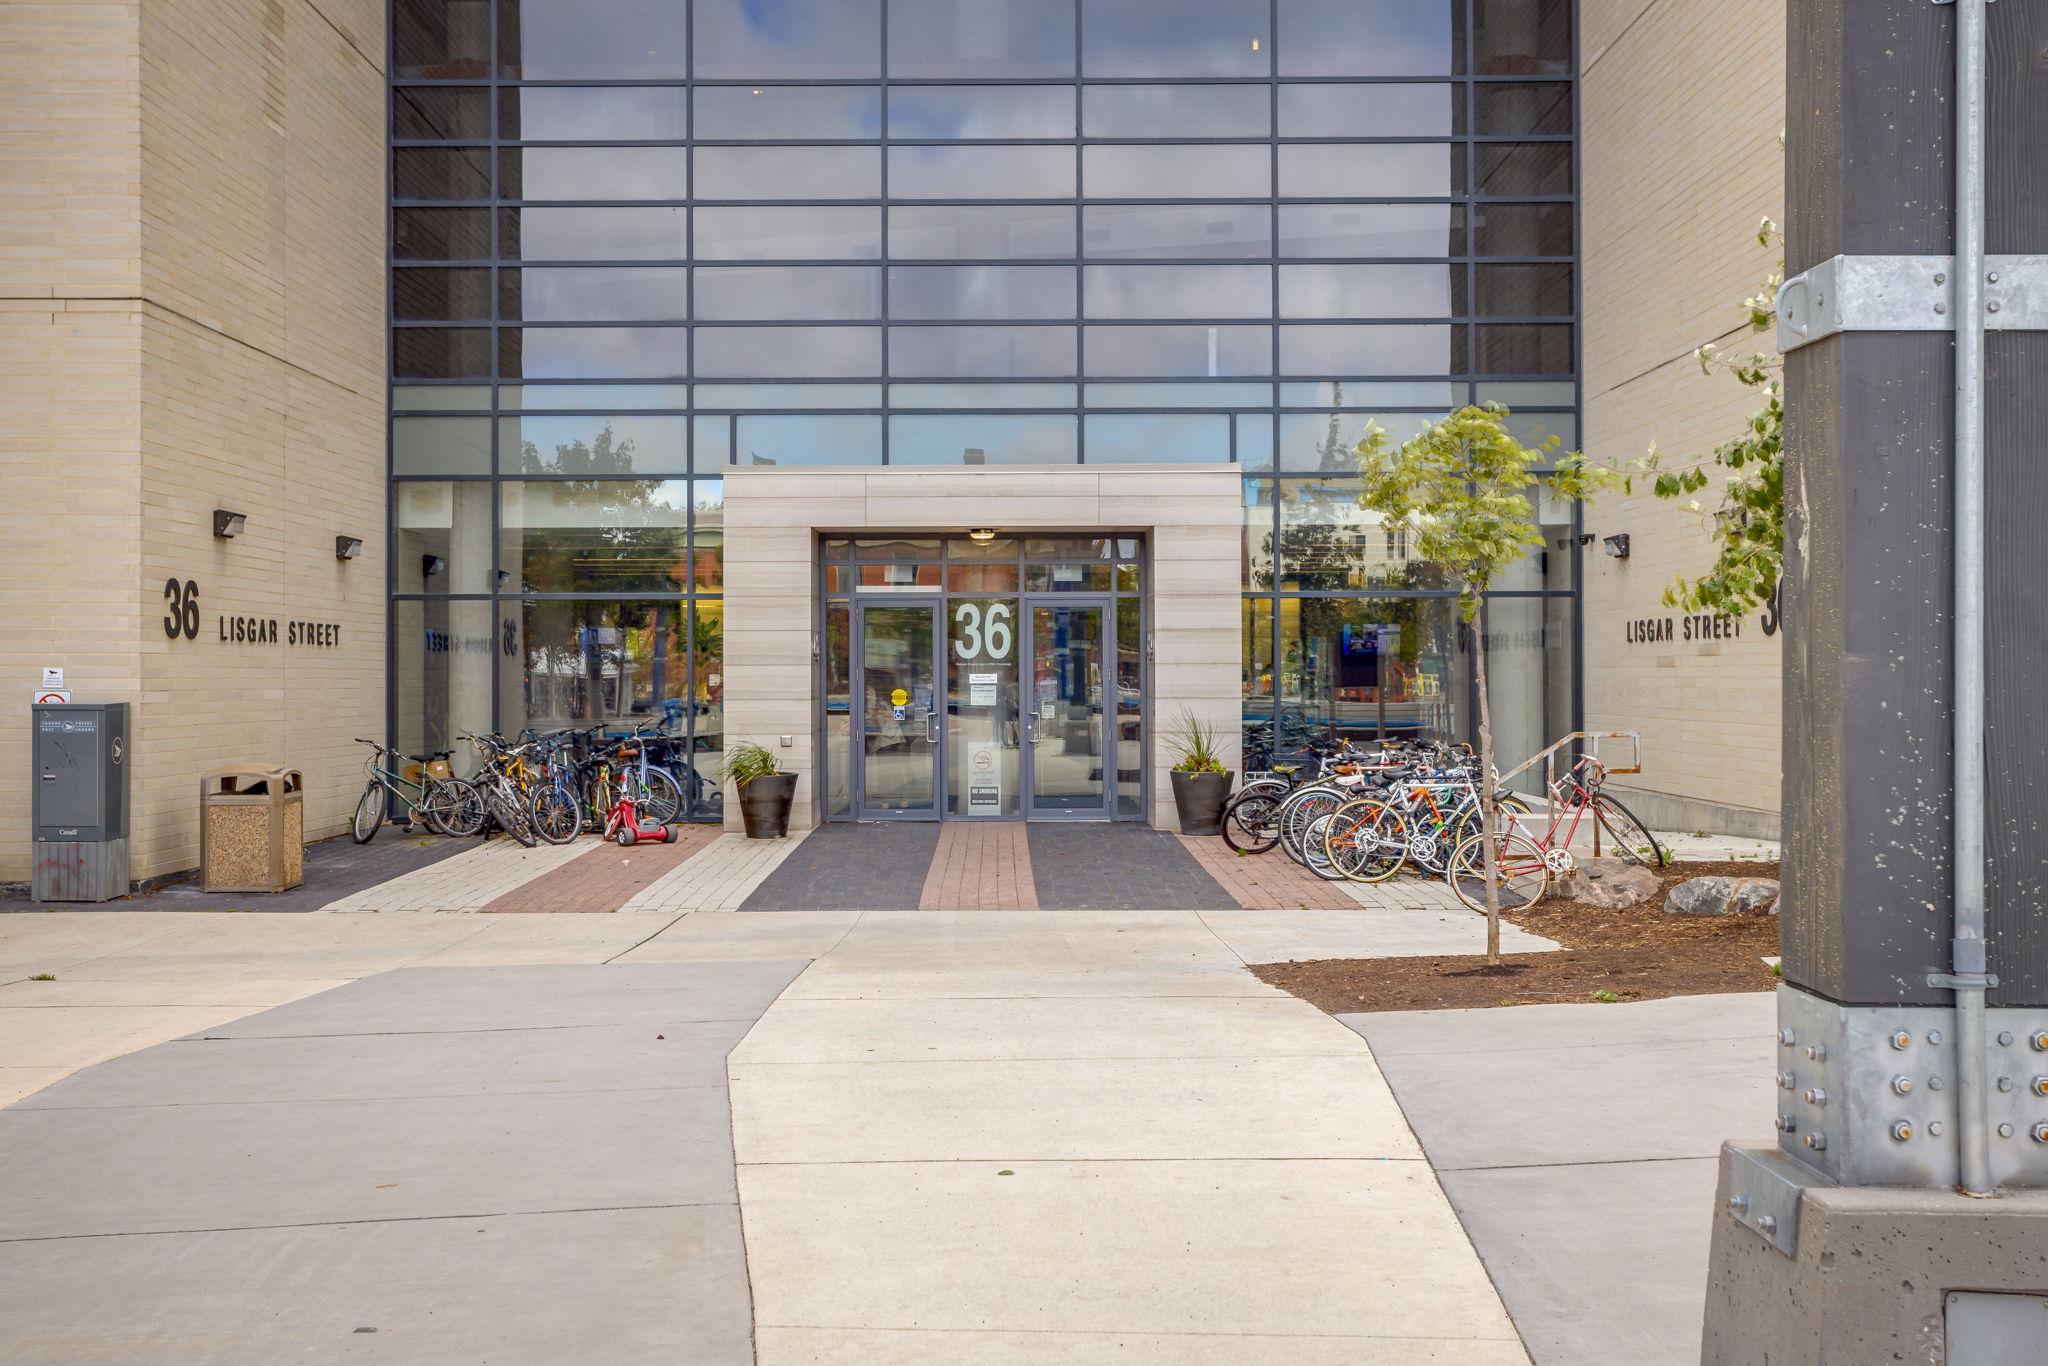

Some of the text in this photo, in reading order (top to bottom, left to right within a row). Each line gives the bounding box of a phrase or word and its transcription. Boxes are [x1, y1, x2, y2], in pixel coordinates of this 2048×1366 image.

[163, 577, 200, 640] 36
[219, 615, 341, 647] LISGAR STREET
[955, 603, 1012, 660] 36
[1626, 617, 1674, 643] LISGAR
[1760, 577, 1783, 636] 3
